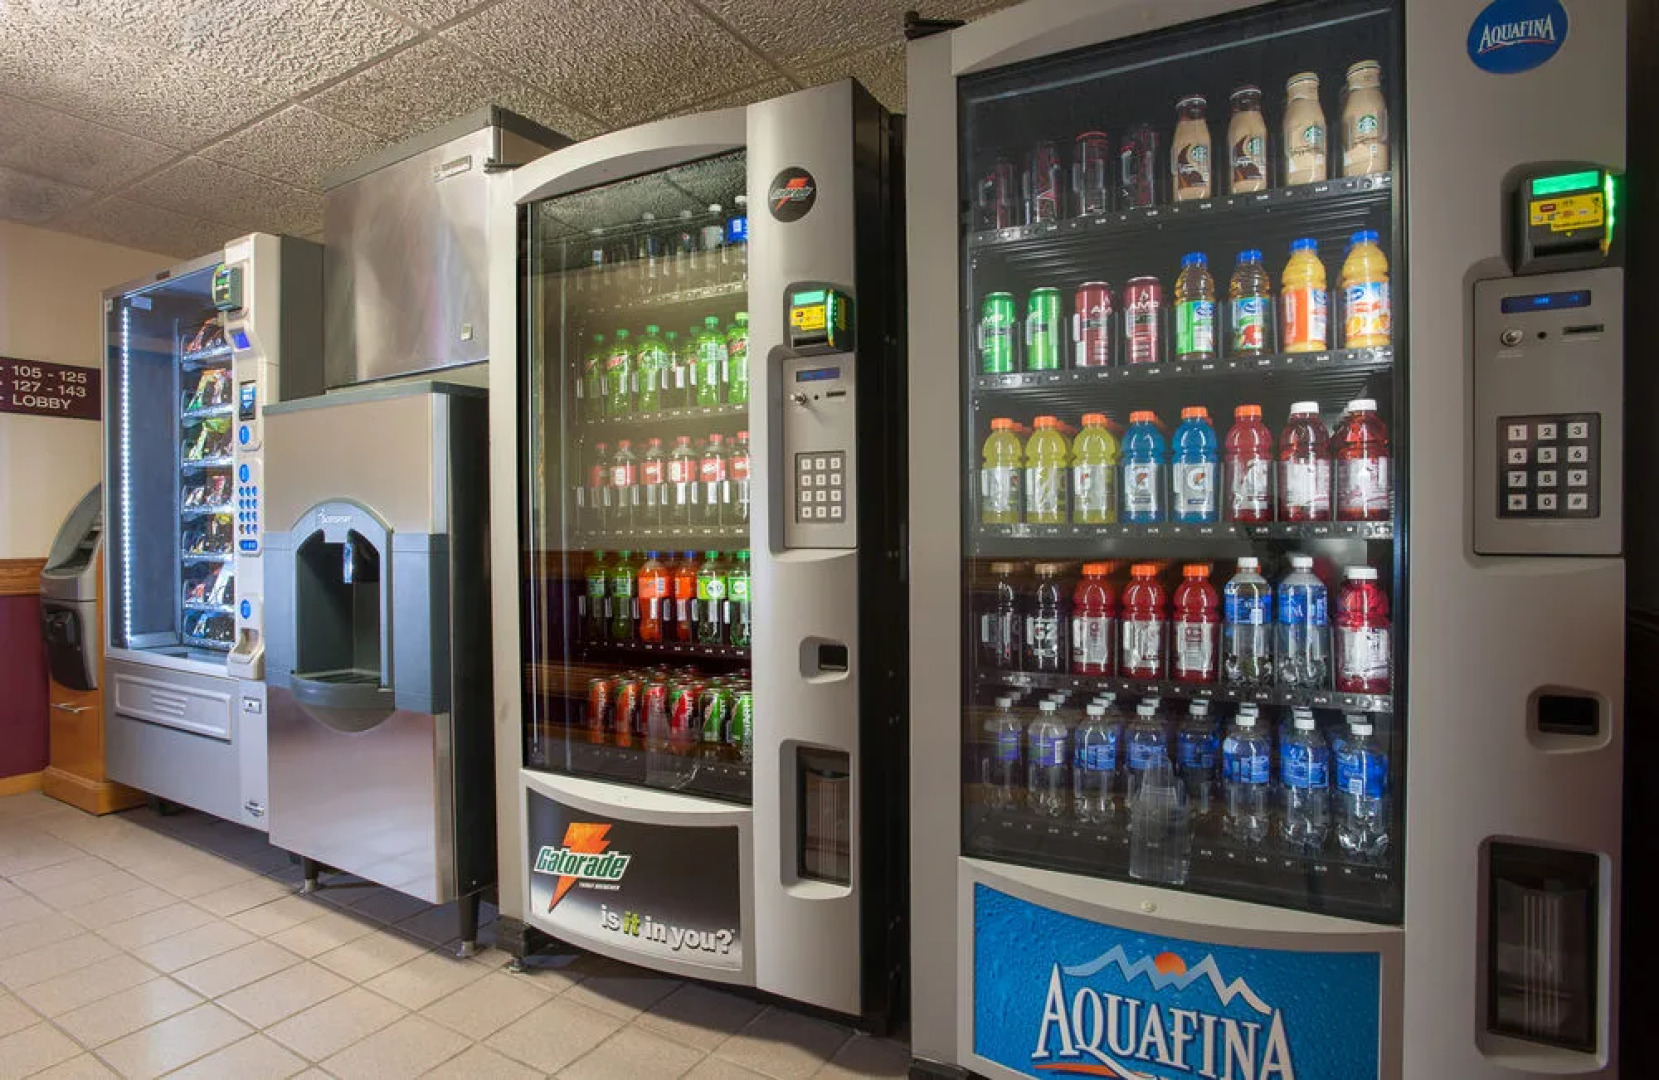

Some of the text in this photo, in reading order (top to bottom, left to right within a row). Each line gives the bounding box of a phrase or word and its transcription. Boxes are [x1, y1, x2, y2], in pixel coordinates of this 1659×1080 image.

[1476, 13, 1554, 53] AQUAFINA
[12, 365, 42, 378] 105
[59, 371, 87, 383] 125
[12, 380, 41, 392] 127
[58, 385, 86, 397] 143
[12, 394, 71, 410] LOBBY
[1543, 427, 1552, 437] 2
[1573, 426, 1582, 436] 3
[1543, 450, 1552, 460] 5
[1543, 474, 1552, 484] 8
[1543, 497, 1552, 507] 0
[535, 846, 629, 879] Gatorade
[601, 904, 733, 954] is it in you?
[1032, 962, 1295, 1080] AQUAFINA
